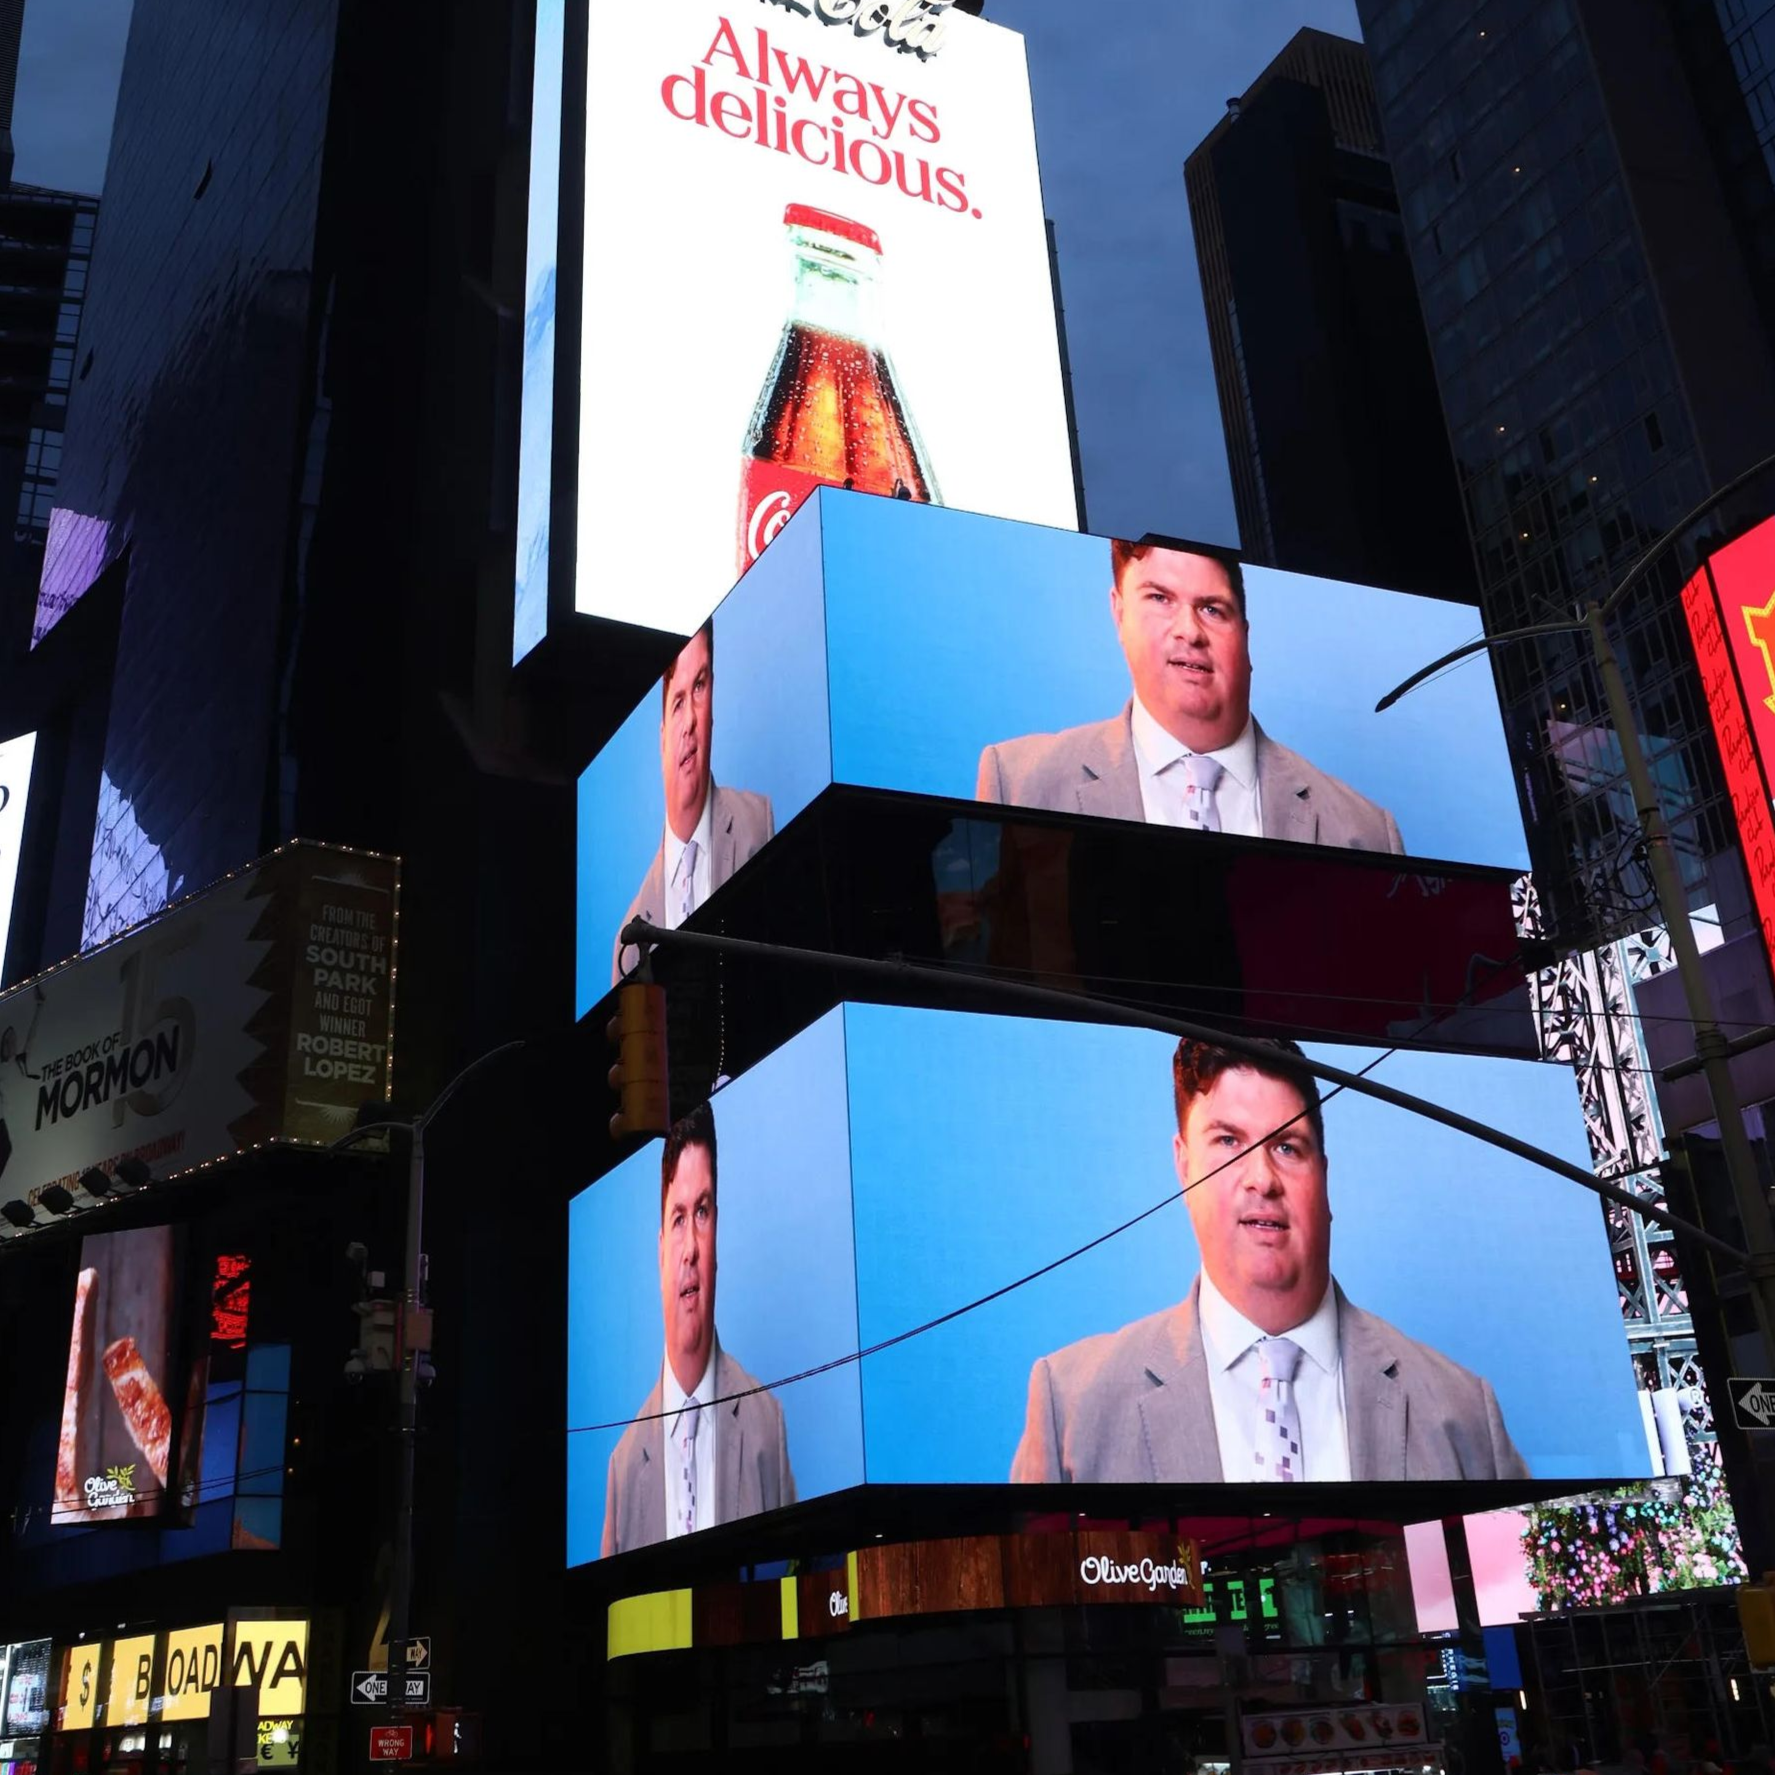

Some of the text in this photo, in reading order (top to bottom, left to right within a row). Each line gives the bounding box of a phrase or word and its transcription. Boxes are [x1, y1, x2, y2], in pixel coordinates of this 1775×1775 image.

[702, 16, 942, 144] Always
[661, 66, 983, 220] delicious.
[322, 904, 376, 930] FROM THE
[309, 923, 386, 952] CREATORS OF
[306, 944, 387, 975] SOUTH
[313, 967, 378, 995] PARK
[314, 990, 373, 1017] AND EGOT
[319, 1014, 366, 1038] WINNER
[41, 1031, 121, 1083] THE BOOK OF
[297, 1032, 387, 1063] ROBERT
[35, 1025, 180, 1131] MORMON
[304, 1056, 377, 1085] LOPEZ
[1750, 1394, 1775, 1415] ONE
[84, 1475, 118, 1494] Olive
[87, 1489, 135, 1511] Garden
[1080, 1555, 1141, 1585] Olive
[1140, 1557, 1188, 1592] Garden
[410, 1646, 423, 1659] WAY
[365, 1681, 421, 1695] ONE AY
[377, 1739, 405, 1748] WRONG
[382, 1748, 400, 1757] WAY
